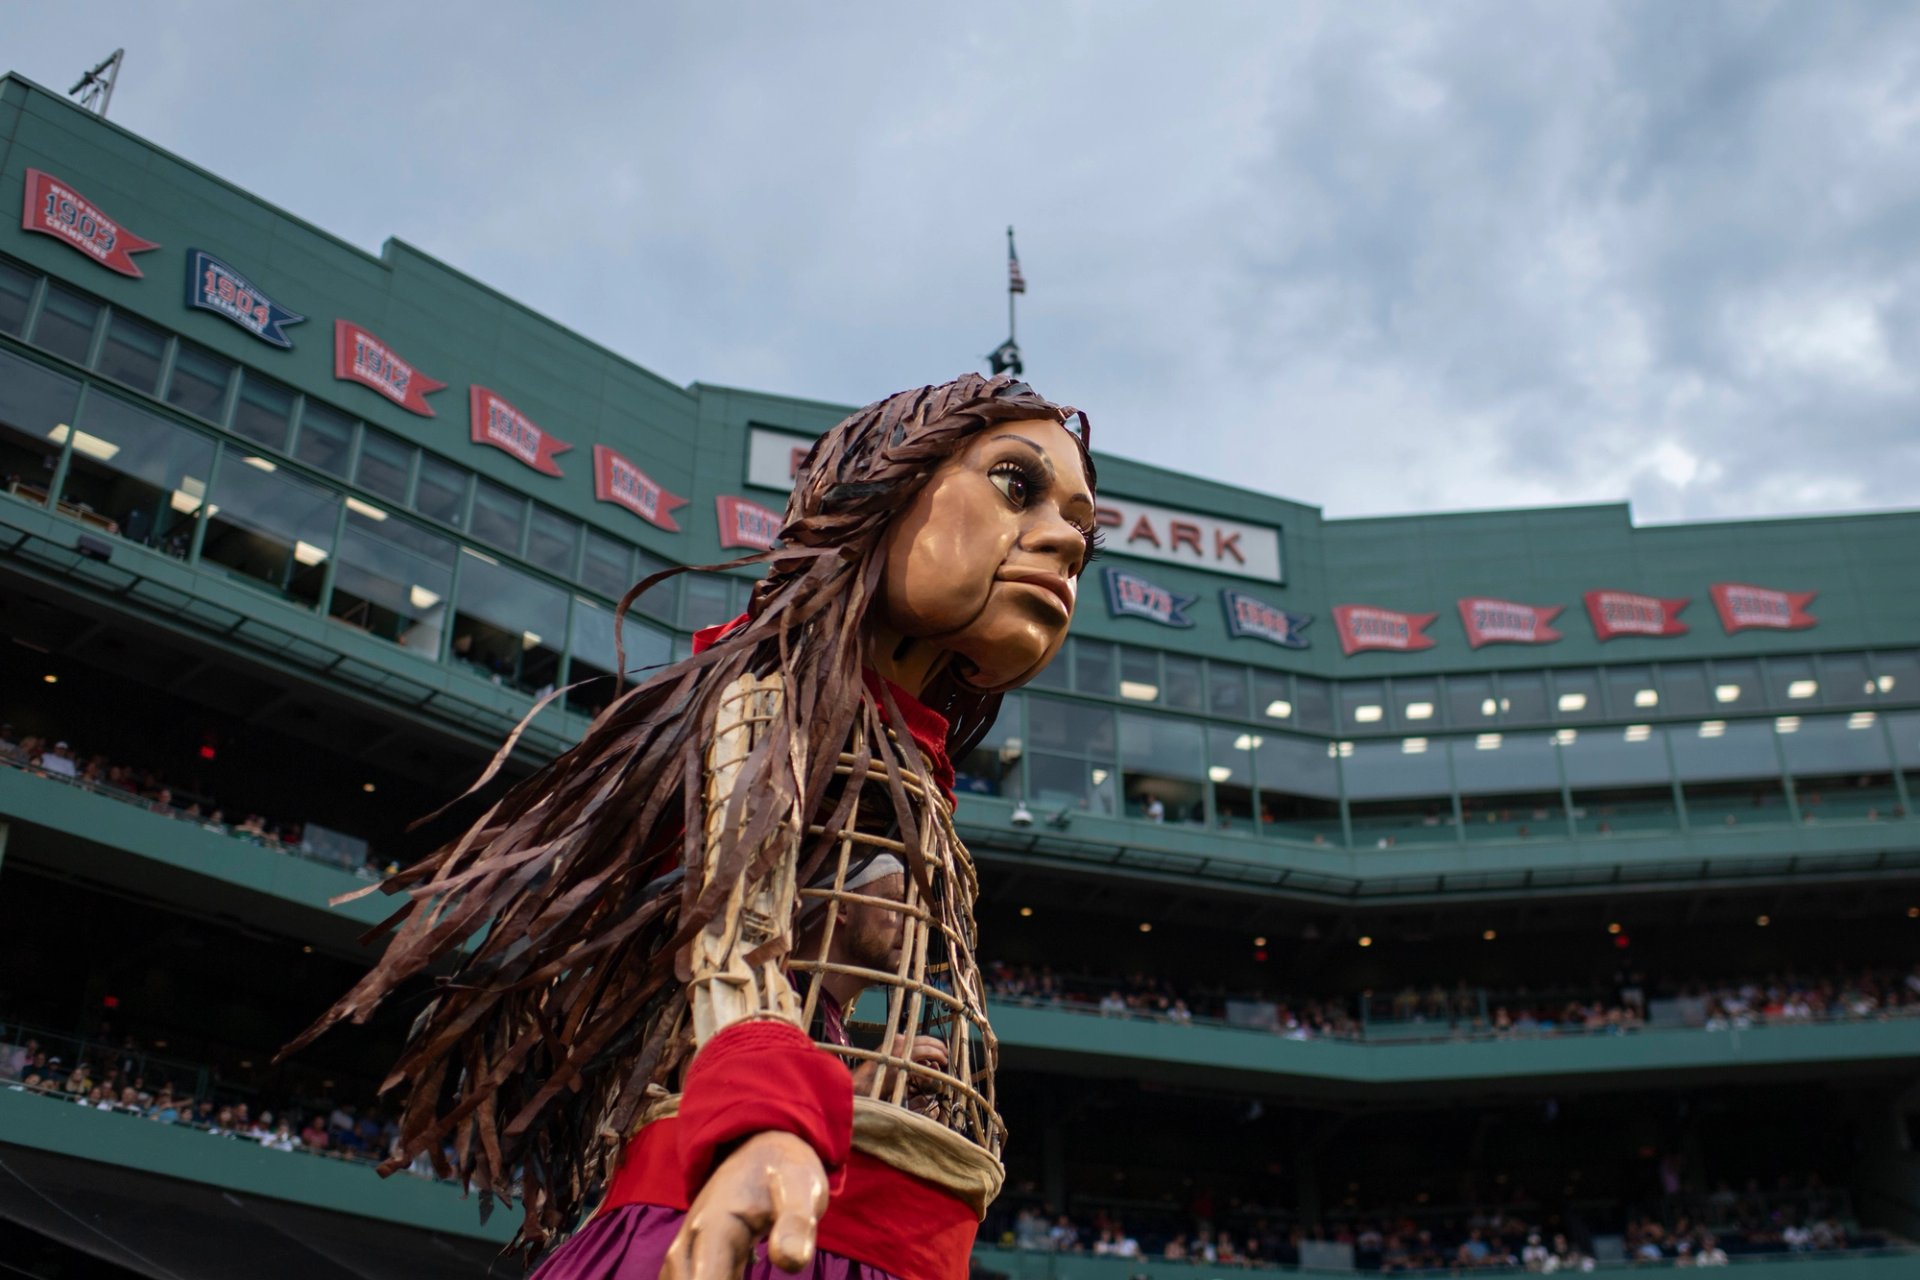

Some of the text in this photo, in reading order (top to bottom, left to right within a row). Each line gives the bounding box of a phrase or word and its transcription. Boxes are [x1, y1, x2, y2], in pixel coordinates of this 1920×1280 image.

[50, 184, 84, 211] WORLD
[45, 193, 117, 253] 1903
[45, 216, 107, 259] CHAMPIONS
[204, 270, 270, 326] 1904
[206, 293, 264, 333] CHAMPIONS
[355, 342, 410, 390] 1912
[488, 405, 538, 454] 1915
